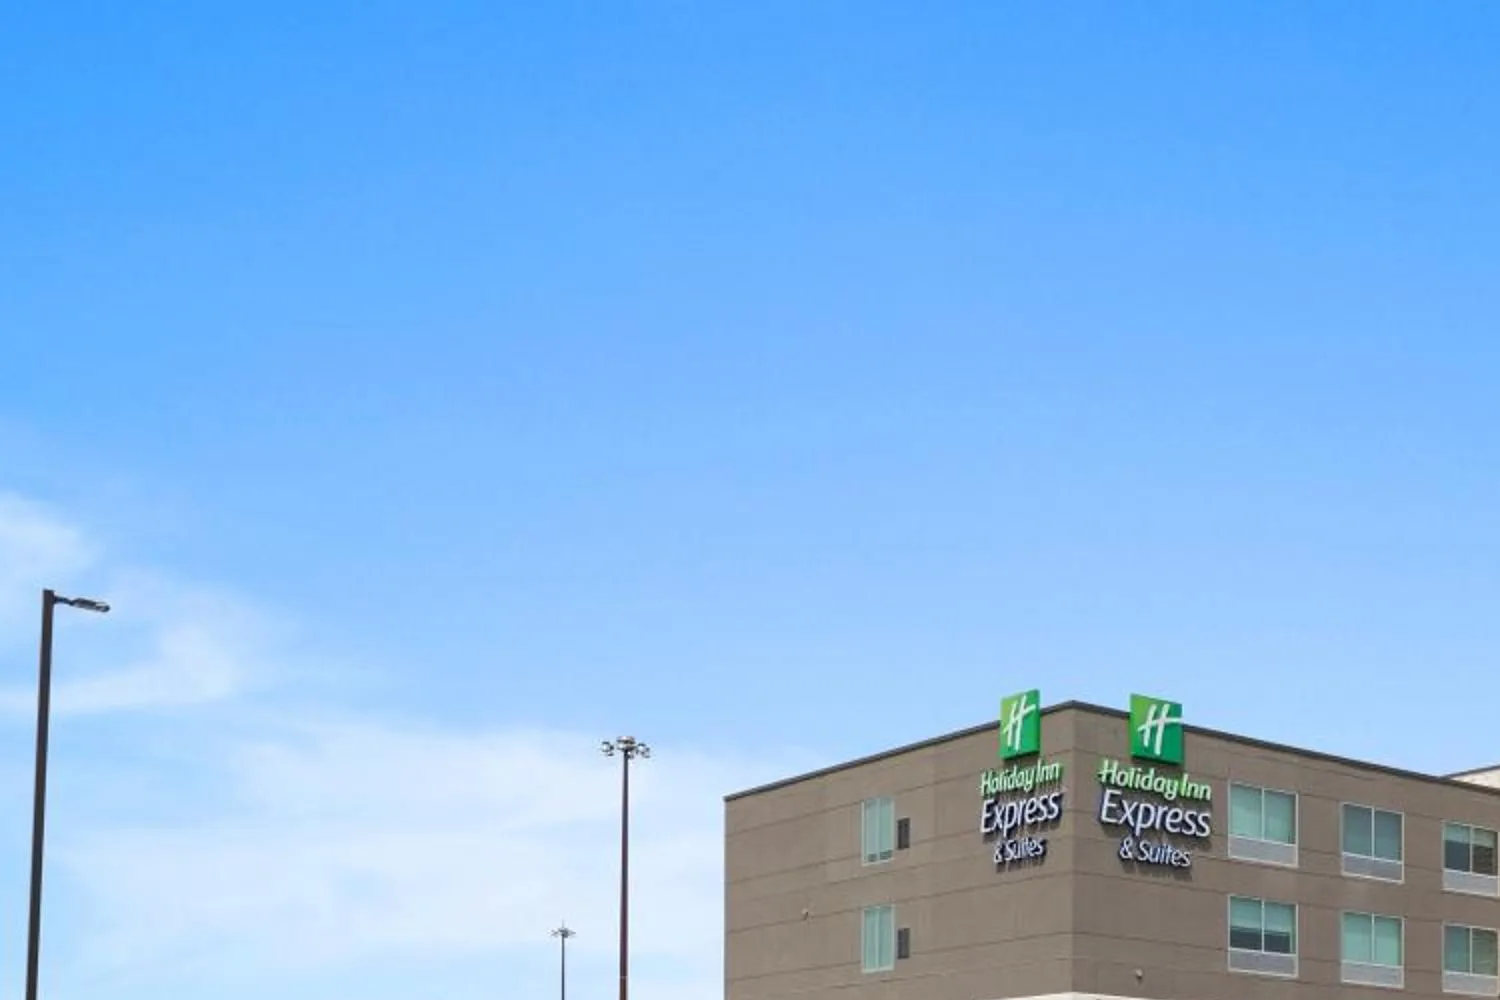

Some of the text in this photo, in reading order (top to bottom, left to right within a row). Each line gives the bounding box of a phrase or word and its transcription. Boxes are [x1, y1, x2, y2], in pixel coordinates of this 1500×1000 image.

[980, 759, 1060, 797] Holiday Inn
[1098, 759, 1212, 801] Holiday Inn
[980, 791, 1061, 838] Express
[1101, 788, 1212, 838] Express
[1004, 837, 1044, 862] Suites
[1119, 836, 1192, 868] & Suites
